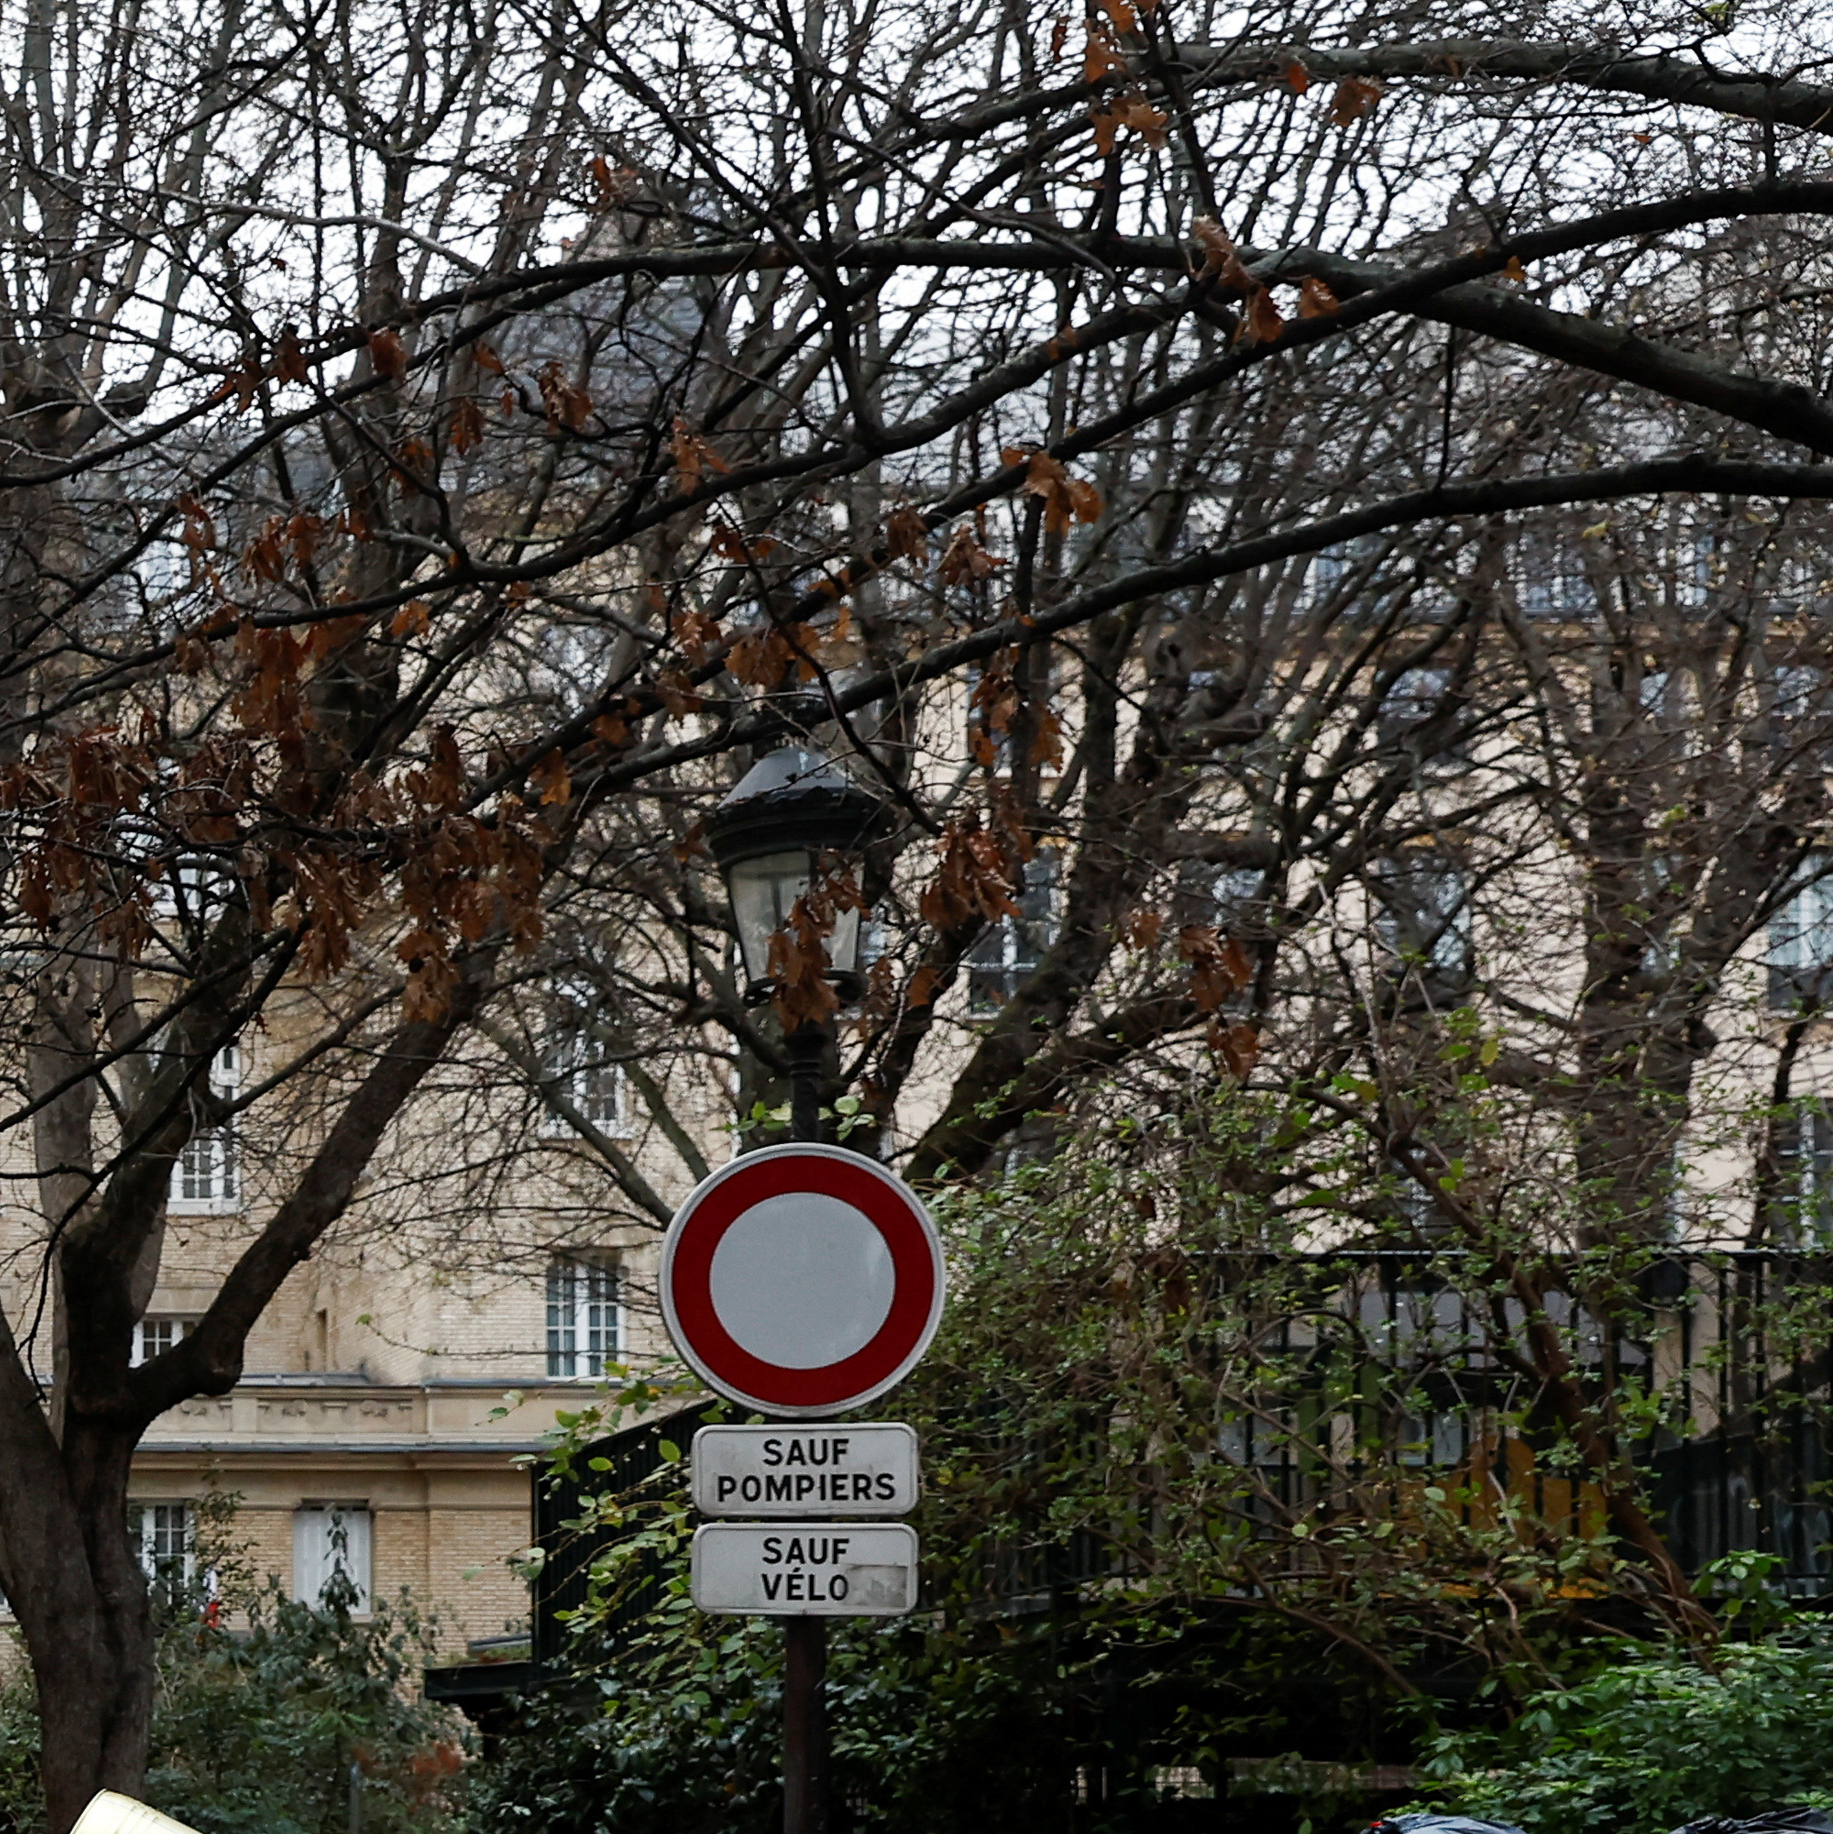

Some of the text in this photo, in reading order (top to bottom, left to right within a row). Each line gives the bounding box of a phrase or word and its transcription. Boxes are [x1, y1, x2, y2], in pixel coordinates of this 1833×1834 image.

[762, 1438, 850, 1466] SAUF
[717, 1473, 896, 1502] POMPIERS
[762, 1537, 850, 1565] SAUF
[762, 1568, 849, 1601] VÉLO
